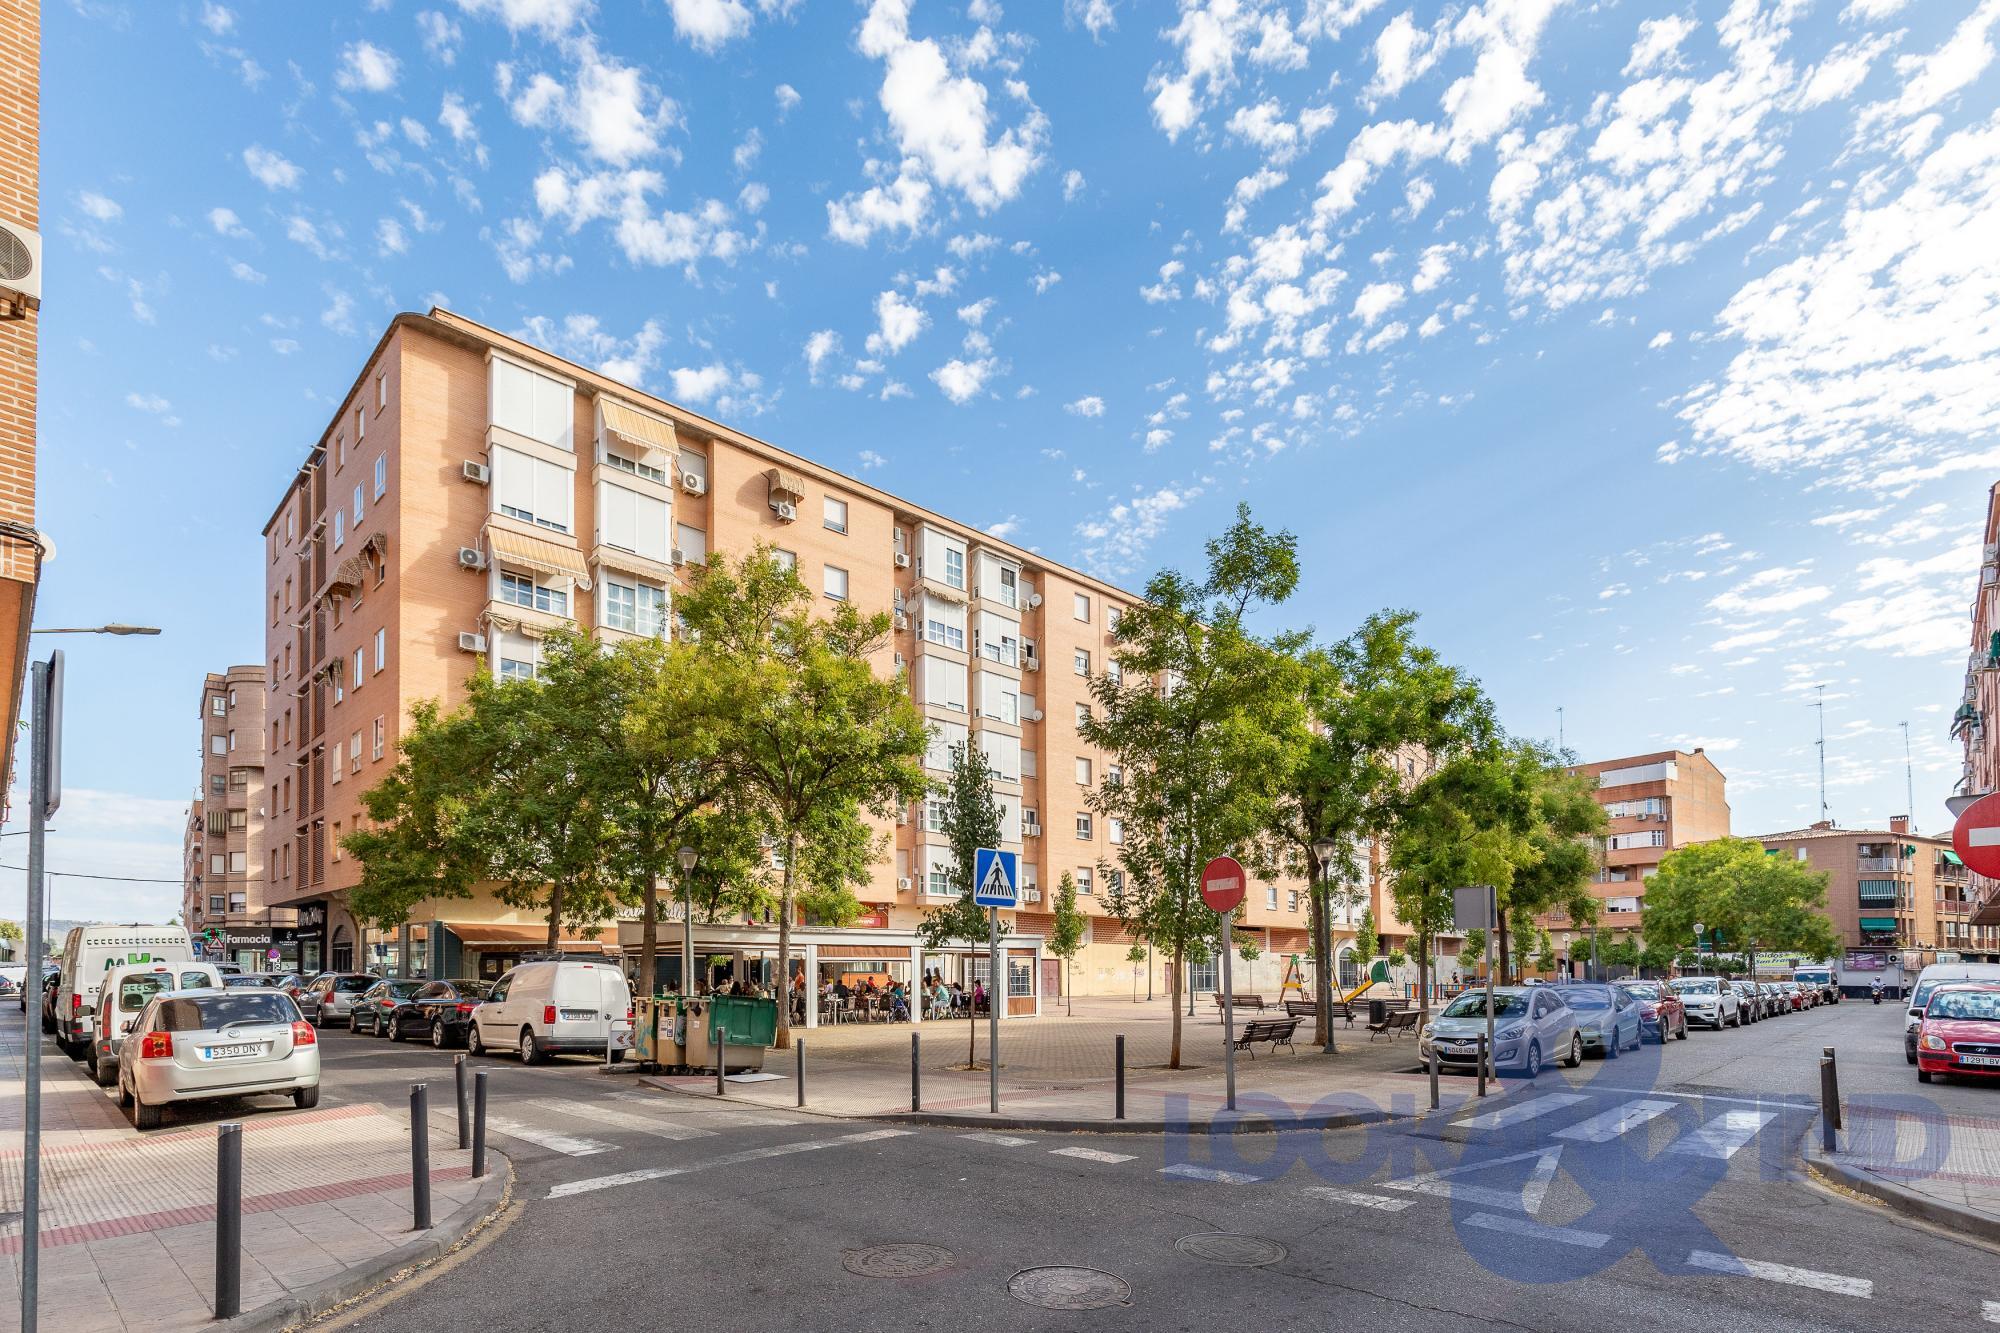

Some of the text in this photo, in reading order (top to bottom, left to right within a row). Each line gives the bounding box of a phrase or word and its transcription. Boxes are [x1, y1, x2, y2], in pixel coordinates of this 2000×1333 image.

[226, 934, 271, 944] Farmacia
[213, 1045, 261, 1056] 5350 DNX
